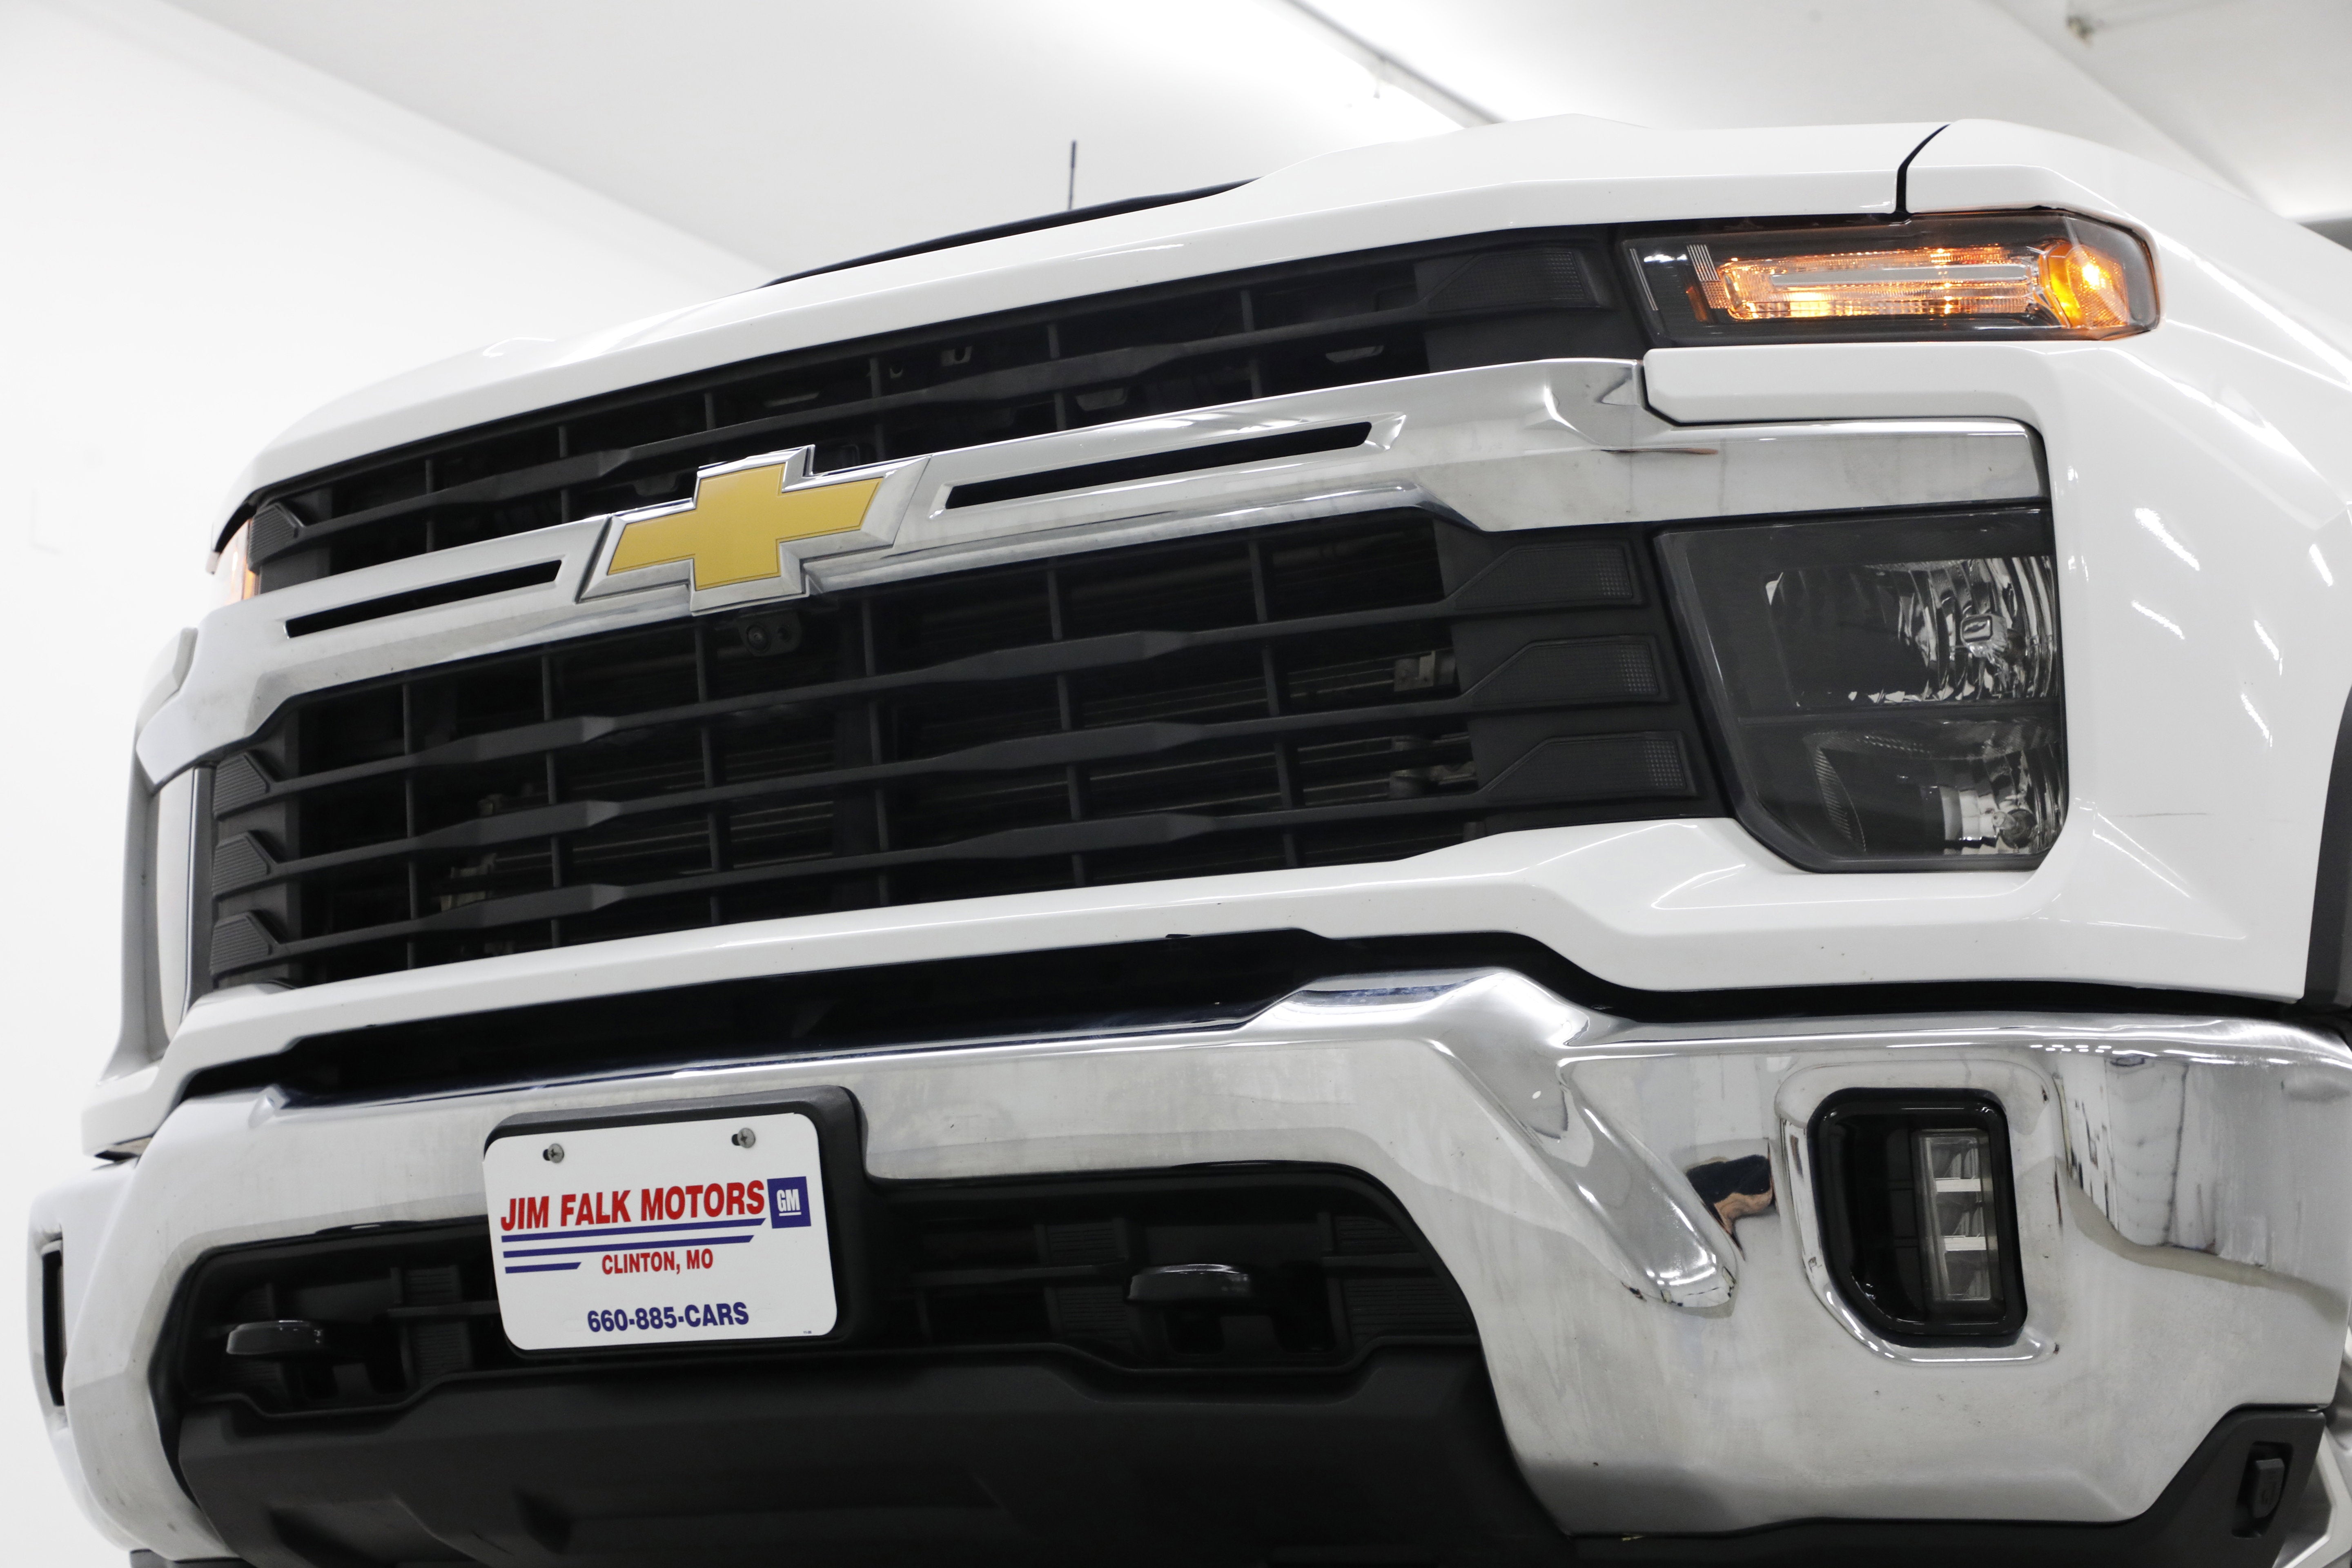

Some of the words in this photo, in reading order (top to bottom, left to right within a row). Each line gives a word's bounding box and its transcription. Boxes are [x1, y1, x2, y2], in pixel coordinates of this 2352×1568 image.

[501, 1196, 550, 1231] JIM
[561, 1190, 631, 1227] FALK
[641, 1180, 765, 1221] MOTORS
[777, 1189, 800, 1212] GM
[602, 1251, 680, 1275] CLINTON,
[686, 1248, 713, 1269] MO
[587, 1301, 749, 1332] 660-885-CARS
